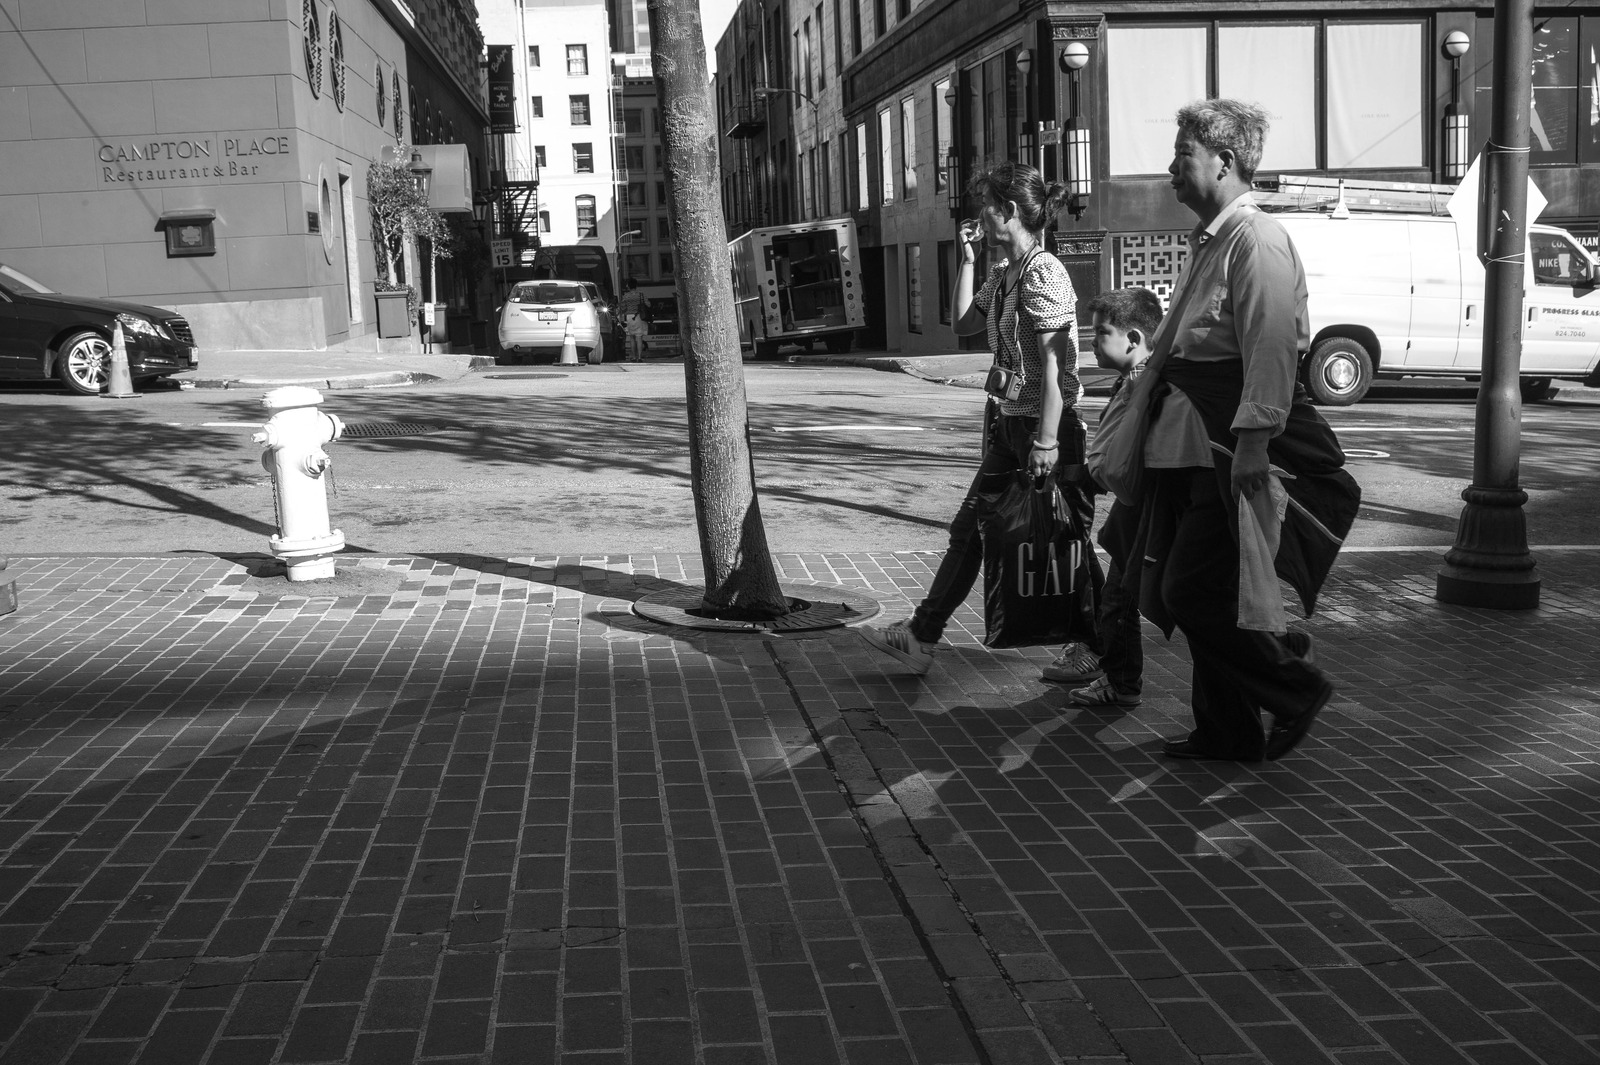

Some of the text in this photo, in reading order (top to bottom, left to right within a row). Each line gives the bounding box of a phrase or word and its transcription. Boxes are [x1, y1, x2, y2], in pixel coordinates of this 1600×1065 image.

[98, 136, 290, 163] CAMPTON PLACE
[102, 165, 209, 183] Restaurant
[228, 161, 259, 177] Bar
[496, 254, 510, 265] 15
[1539, 258, 1559, 268] NIKE
[1542, 307, 1579, 315] PROGRESS
[1018, 540, 1081, 598] GAP
